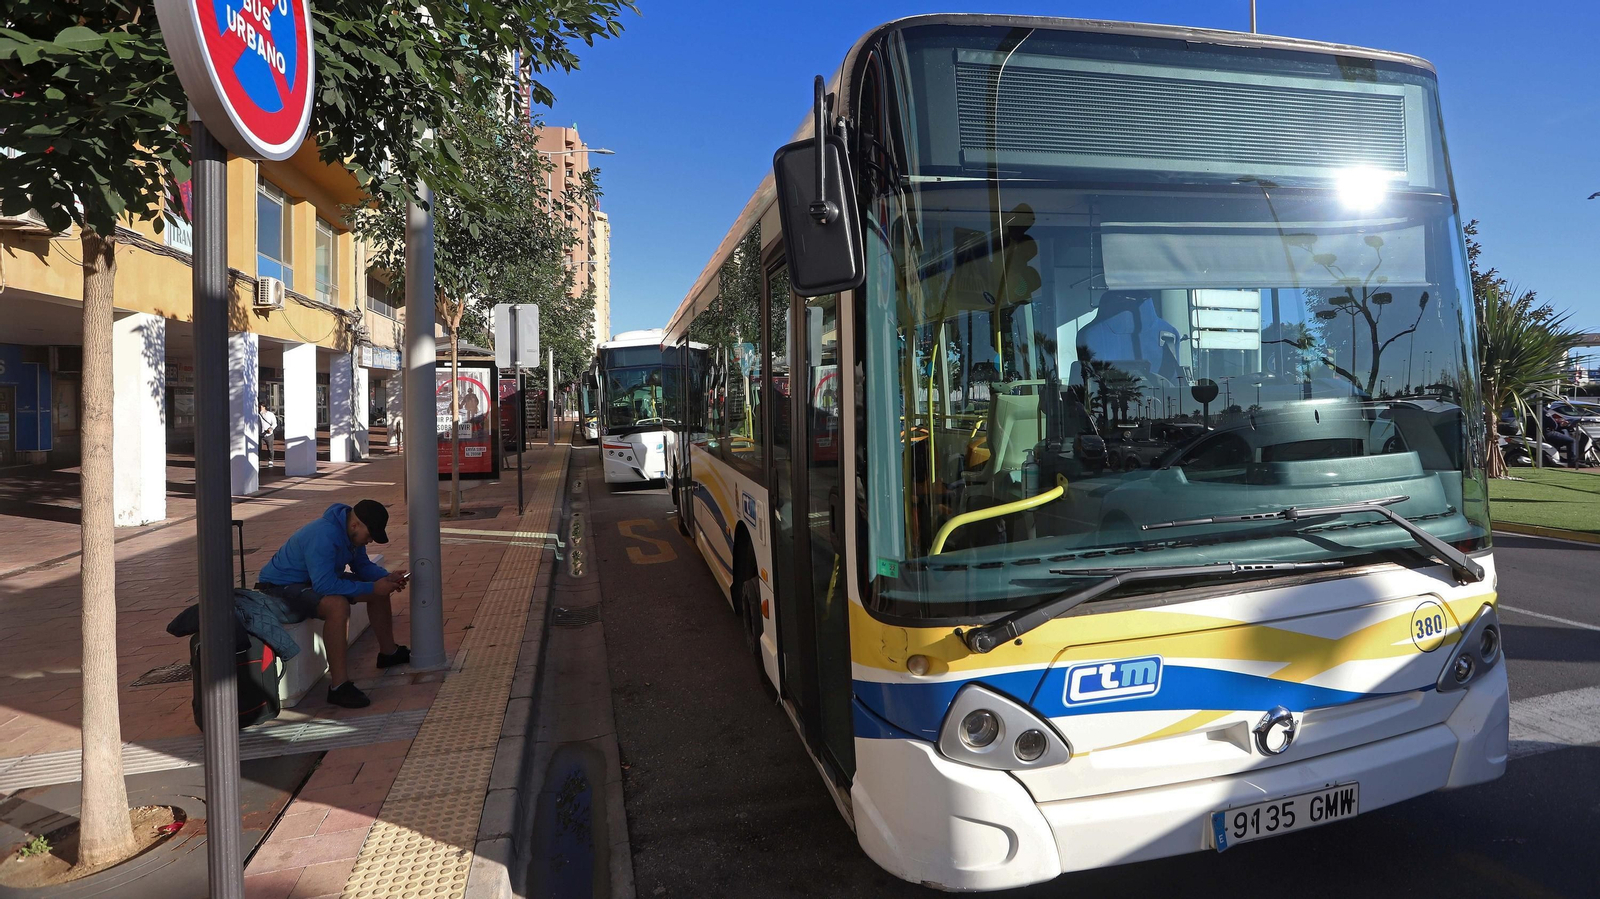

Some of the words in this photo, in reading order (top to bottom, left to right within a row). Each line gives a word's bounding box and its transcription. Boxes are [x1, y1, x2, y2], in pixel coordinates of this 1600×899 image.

[226, 4, 286, 75] URBANO
[1415, 614, 1443, 639] 380
[1233, 801, 1296, 838] 9135
[1309, 788, 1354, 822] GMW
[1218, 834, 1224, 844] E
